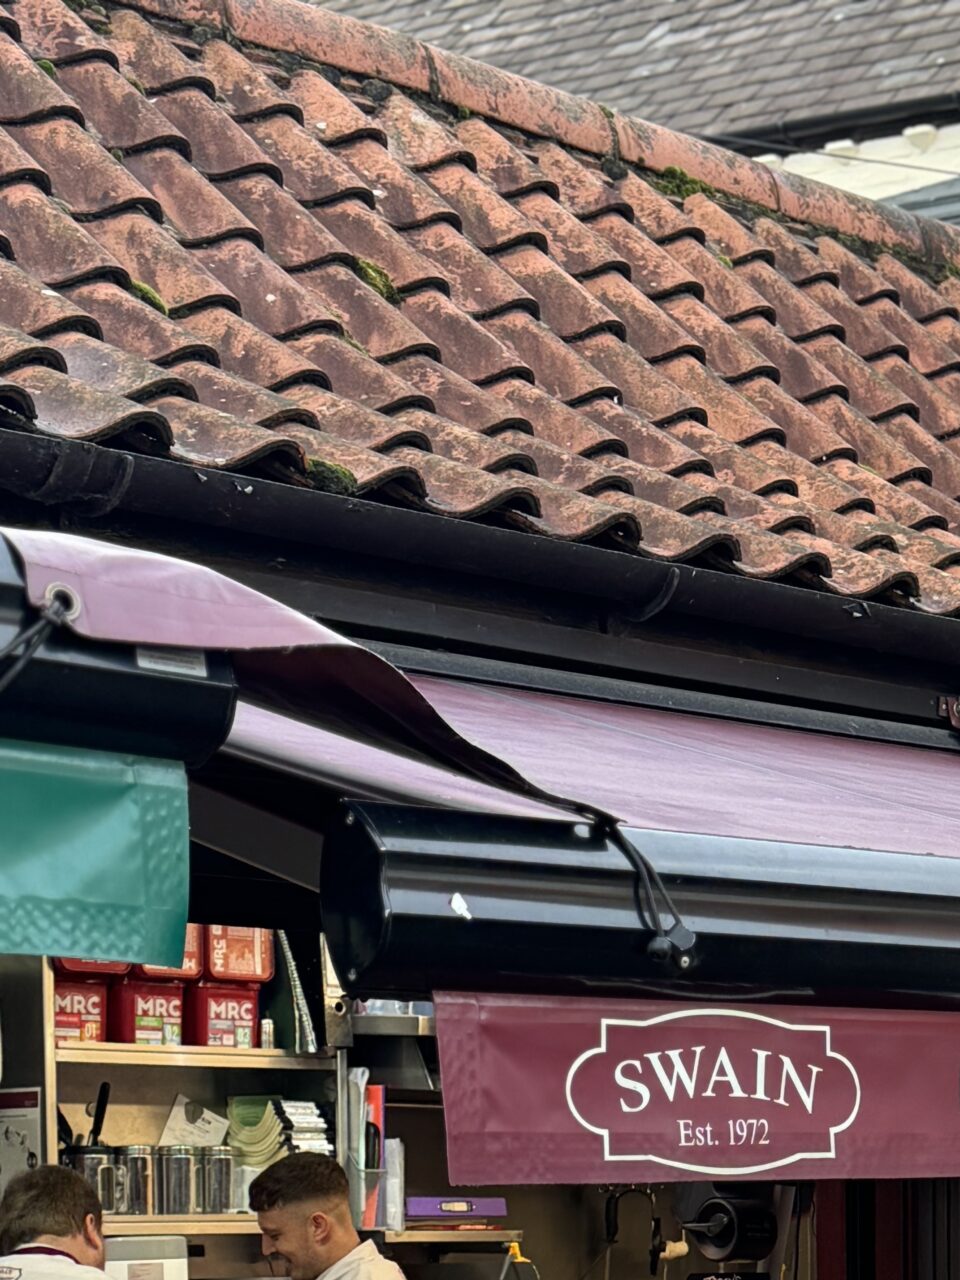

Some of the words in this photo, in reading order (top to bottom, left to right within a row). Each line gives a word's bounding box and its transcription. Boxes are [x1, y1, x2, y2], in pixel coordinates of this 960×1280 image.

[54, 995, 100, 1014] MRC
[135, 995, 181, 1017] MRC
[209, 1001, 253, 1020] MRC
[84, 1022, 97, 1038] 01
[164, 1024, 178, 1040] 02
[236, 1027, 250, 1042] 03
[613, 1043, 824, 1115] SWAIN
[677, 1118, 719, 1147] Est.
[728, 1118, 770, 1146] 1972
